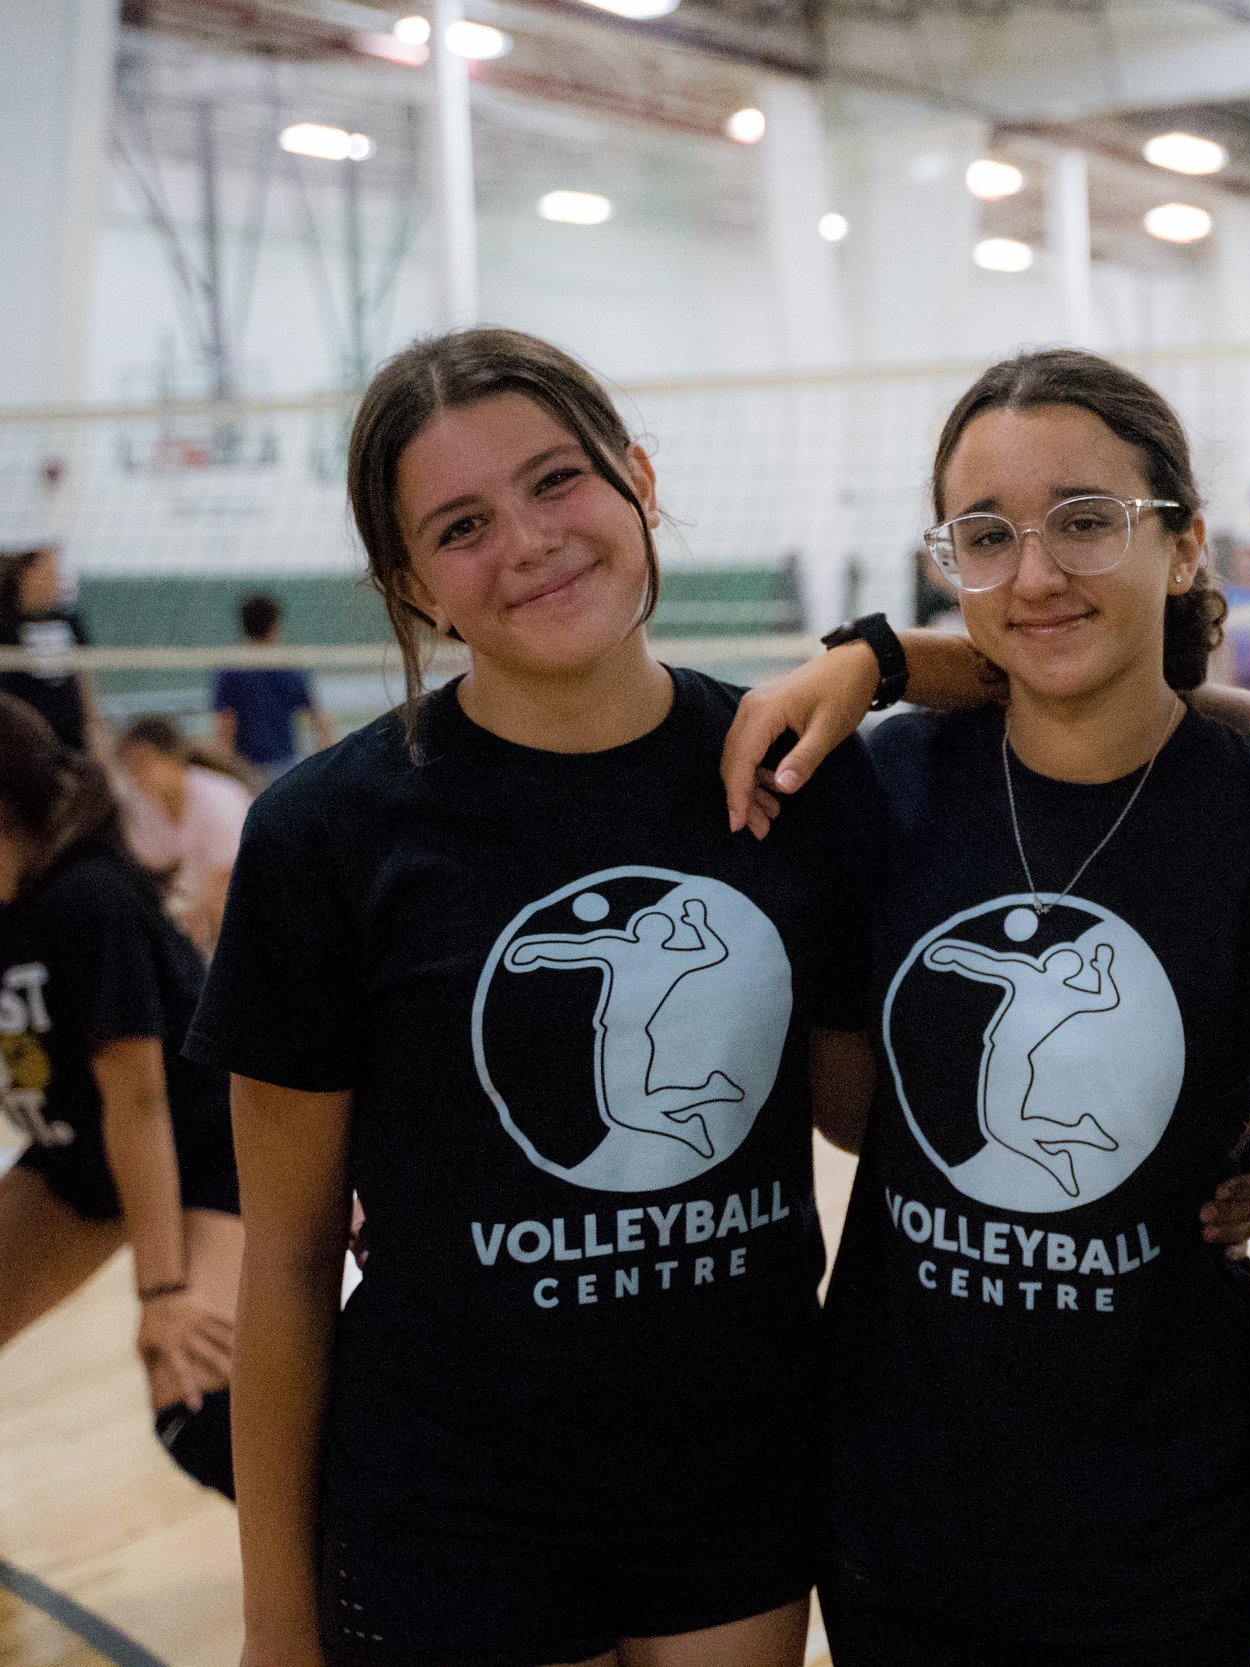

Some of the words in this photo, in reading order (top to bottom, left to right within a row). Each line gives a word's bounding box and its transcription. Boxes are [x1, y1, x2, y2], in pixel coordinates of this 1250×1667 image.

[471, 1180, 790, 1266] VOLLEYBALL
[885, 1186, 1160, 1276] VOLLEYBALL
[533, 1247, 747, 1308] CENTRE
[918, 1260, 1115, 1312] CENTRE
